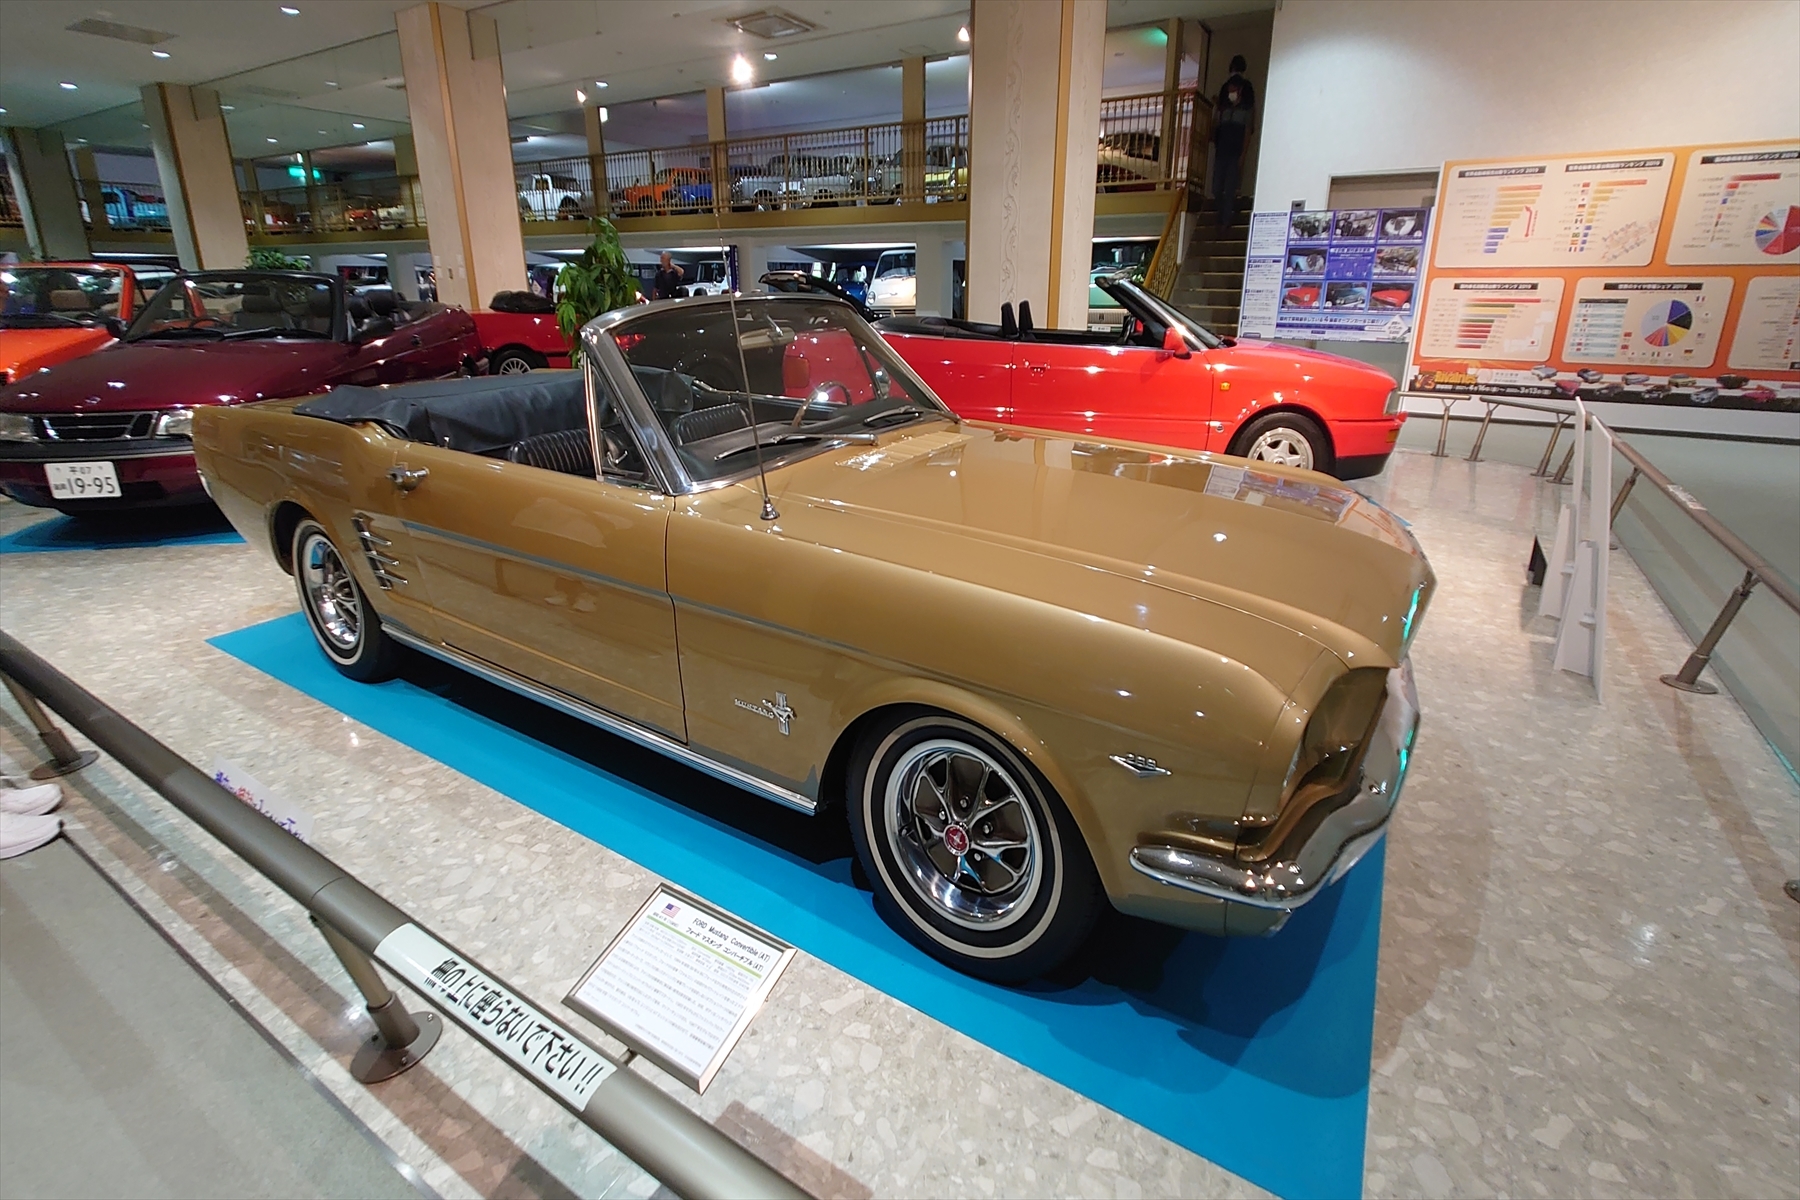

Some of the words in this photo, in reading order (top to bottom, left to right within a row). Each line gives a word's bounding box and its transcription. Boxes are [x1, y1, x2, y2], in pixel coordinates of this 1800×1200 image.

[67, 476, 116, 495] 19-95
[685, 927, 702, 939] フォード
[702, 936, 724, 950] マスタング
[692, 918, 708, 930] FORD
[708, 926, 730, 941] Mustang
